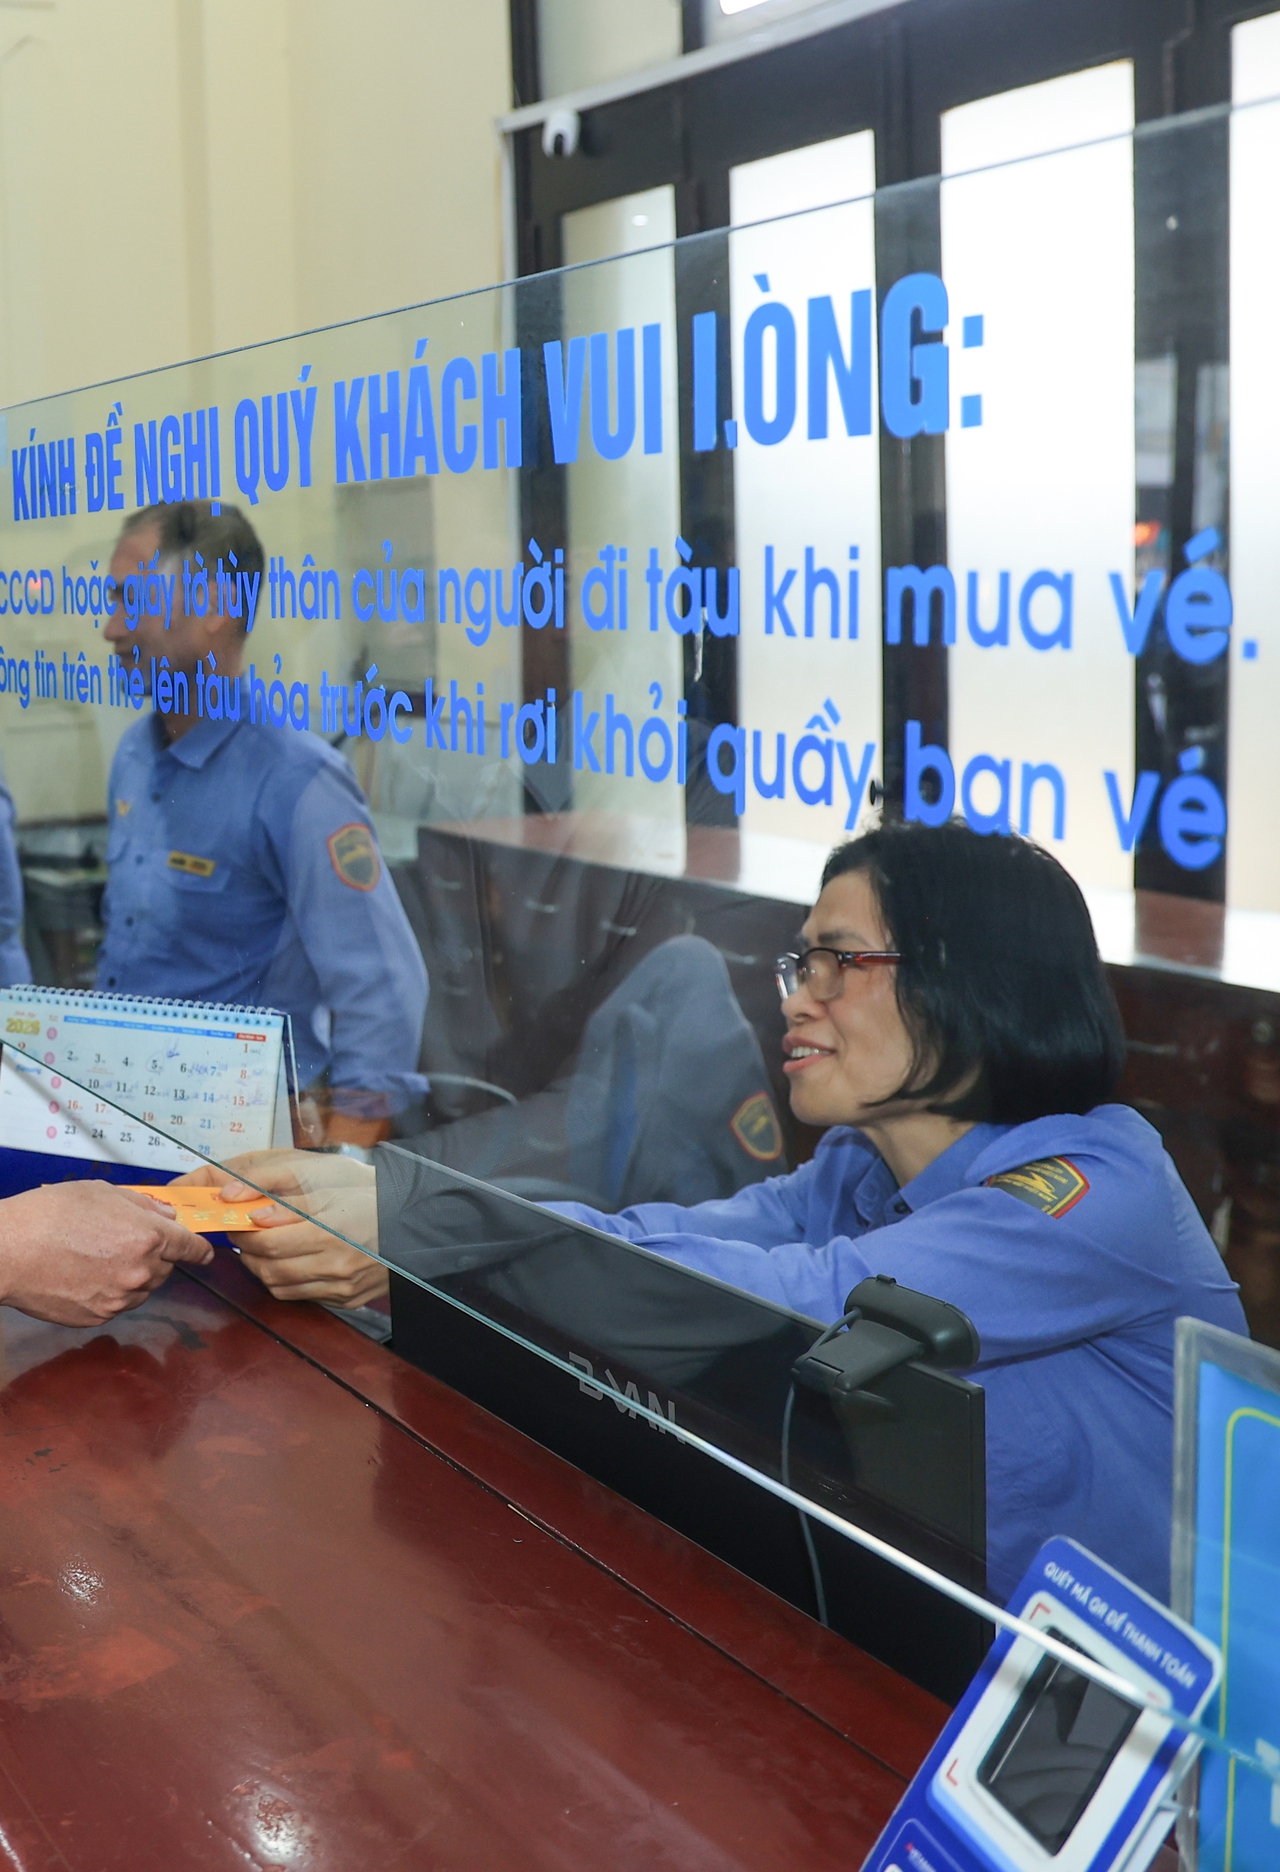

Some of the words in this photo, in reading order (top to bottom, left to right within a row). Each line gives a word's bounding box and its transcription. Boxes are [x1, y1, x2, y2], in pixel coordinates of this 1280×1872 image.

[12, 428, 75, 521] KÍNH
[85, 402, 123, 513] ĐỀ
[134, 406, 221, 516] NGHỊ
[234, 365, 317, 506] QUÝ
[334, 338, 522, 484] KHÁCH
[543, 322, 663, 464] VUI
[62, 560, 117, 628] hoặc
[123, 549, 176, 631] giấy
[182, 551, 209, 618] tờ
[216, 551, 261, 632] tùy
[269, 554, 341, 620] thân
[352, 540, 426, 623] của
[438, 538, 564, 646] người
[580, 544, 628, 632] đi
[646, 535, 740, 637] tàu
[764, 545, 860, 640] khi
[885, 564, 1073, 651] mua
[1108, 526, 1258, 665] vé.
[35, 650, 58, 699] tin
[62, 651, 103, 706] trên
[108, 645, 145, 710] thẻ
[150, 655, 189, 715] lên
[195, 650, 240, 721] tàu
[250, 654, 309, 731] hỏa
[320, 664, 413, 744] trước
[425, 678, 485, 756] khi
[500, 687, 557, 764] rơi
[573, 681, 688, 786] khỏi
[706, 697, 876, 831] quầy
[1103, 745, 1228, 871] vé
[68, 1051, 74, 1061] 2
[95, 1054, 101, 1064] 3
[122, 1057, 129, 1067] 4
[152, 1060, 158, 1070] 5
[180, 1063, 187, 1073] 6
[210, 1066, 217, 1076] 7
[240, 1069, 247, 1080] 8
[89, 1079, 100, 1088] 10
[116, 1082, 127, 1092] 11
[144, 1086, 156, 1096] 12
[174, 1089, 186, 1099] 13
[203, 1092, 215, 1102] 14
[233, 1096, 245, 1106] 15
[64, 1125, 76, 1134] 23
[92, 1129, 104, 1138] 24
[120, 1133, 132, 1142] 25
[148, 1136, 161, 1146] 26
[68, 1100, 79, 1110] 16
[95, 1104, 106, 1113] 17
[170, 1115, 183, 1125] 20
[200, 1119, 212, 1129] 21
[230, 1122, 242, 1133] 22
[1044, 1561, 1075, 1590] QUÉT
[1071, 1582, 1093, 1606] MÃ
[1088, 1596, 1109, 1619] QR
[1104, 1609, 1128, 1632] ĐỂ
[1123, 1622, 1162, 1662] THANH
[1160, 1652, 1197, 1689] TOÁN
